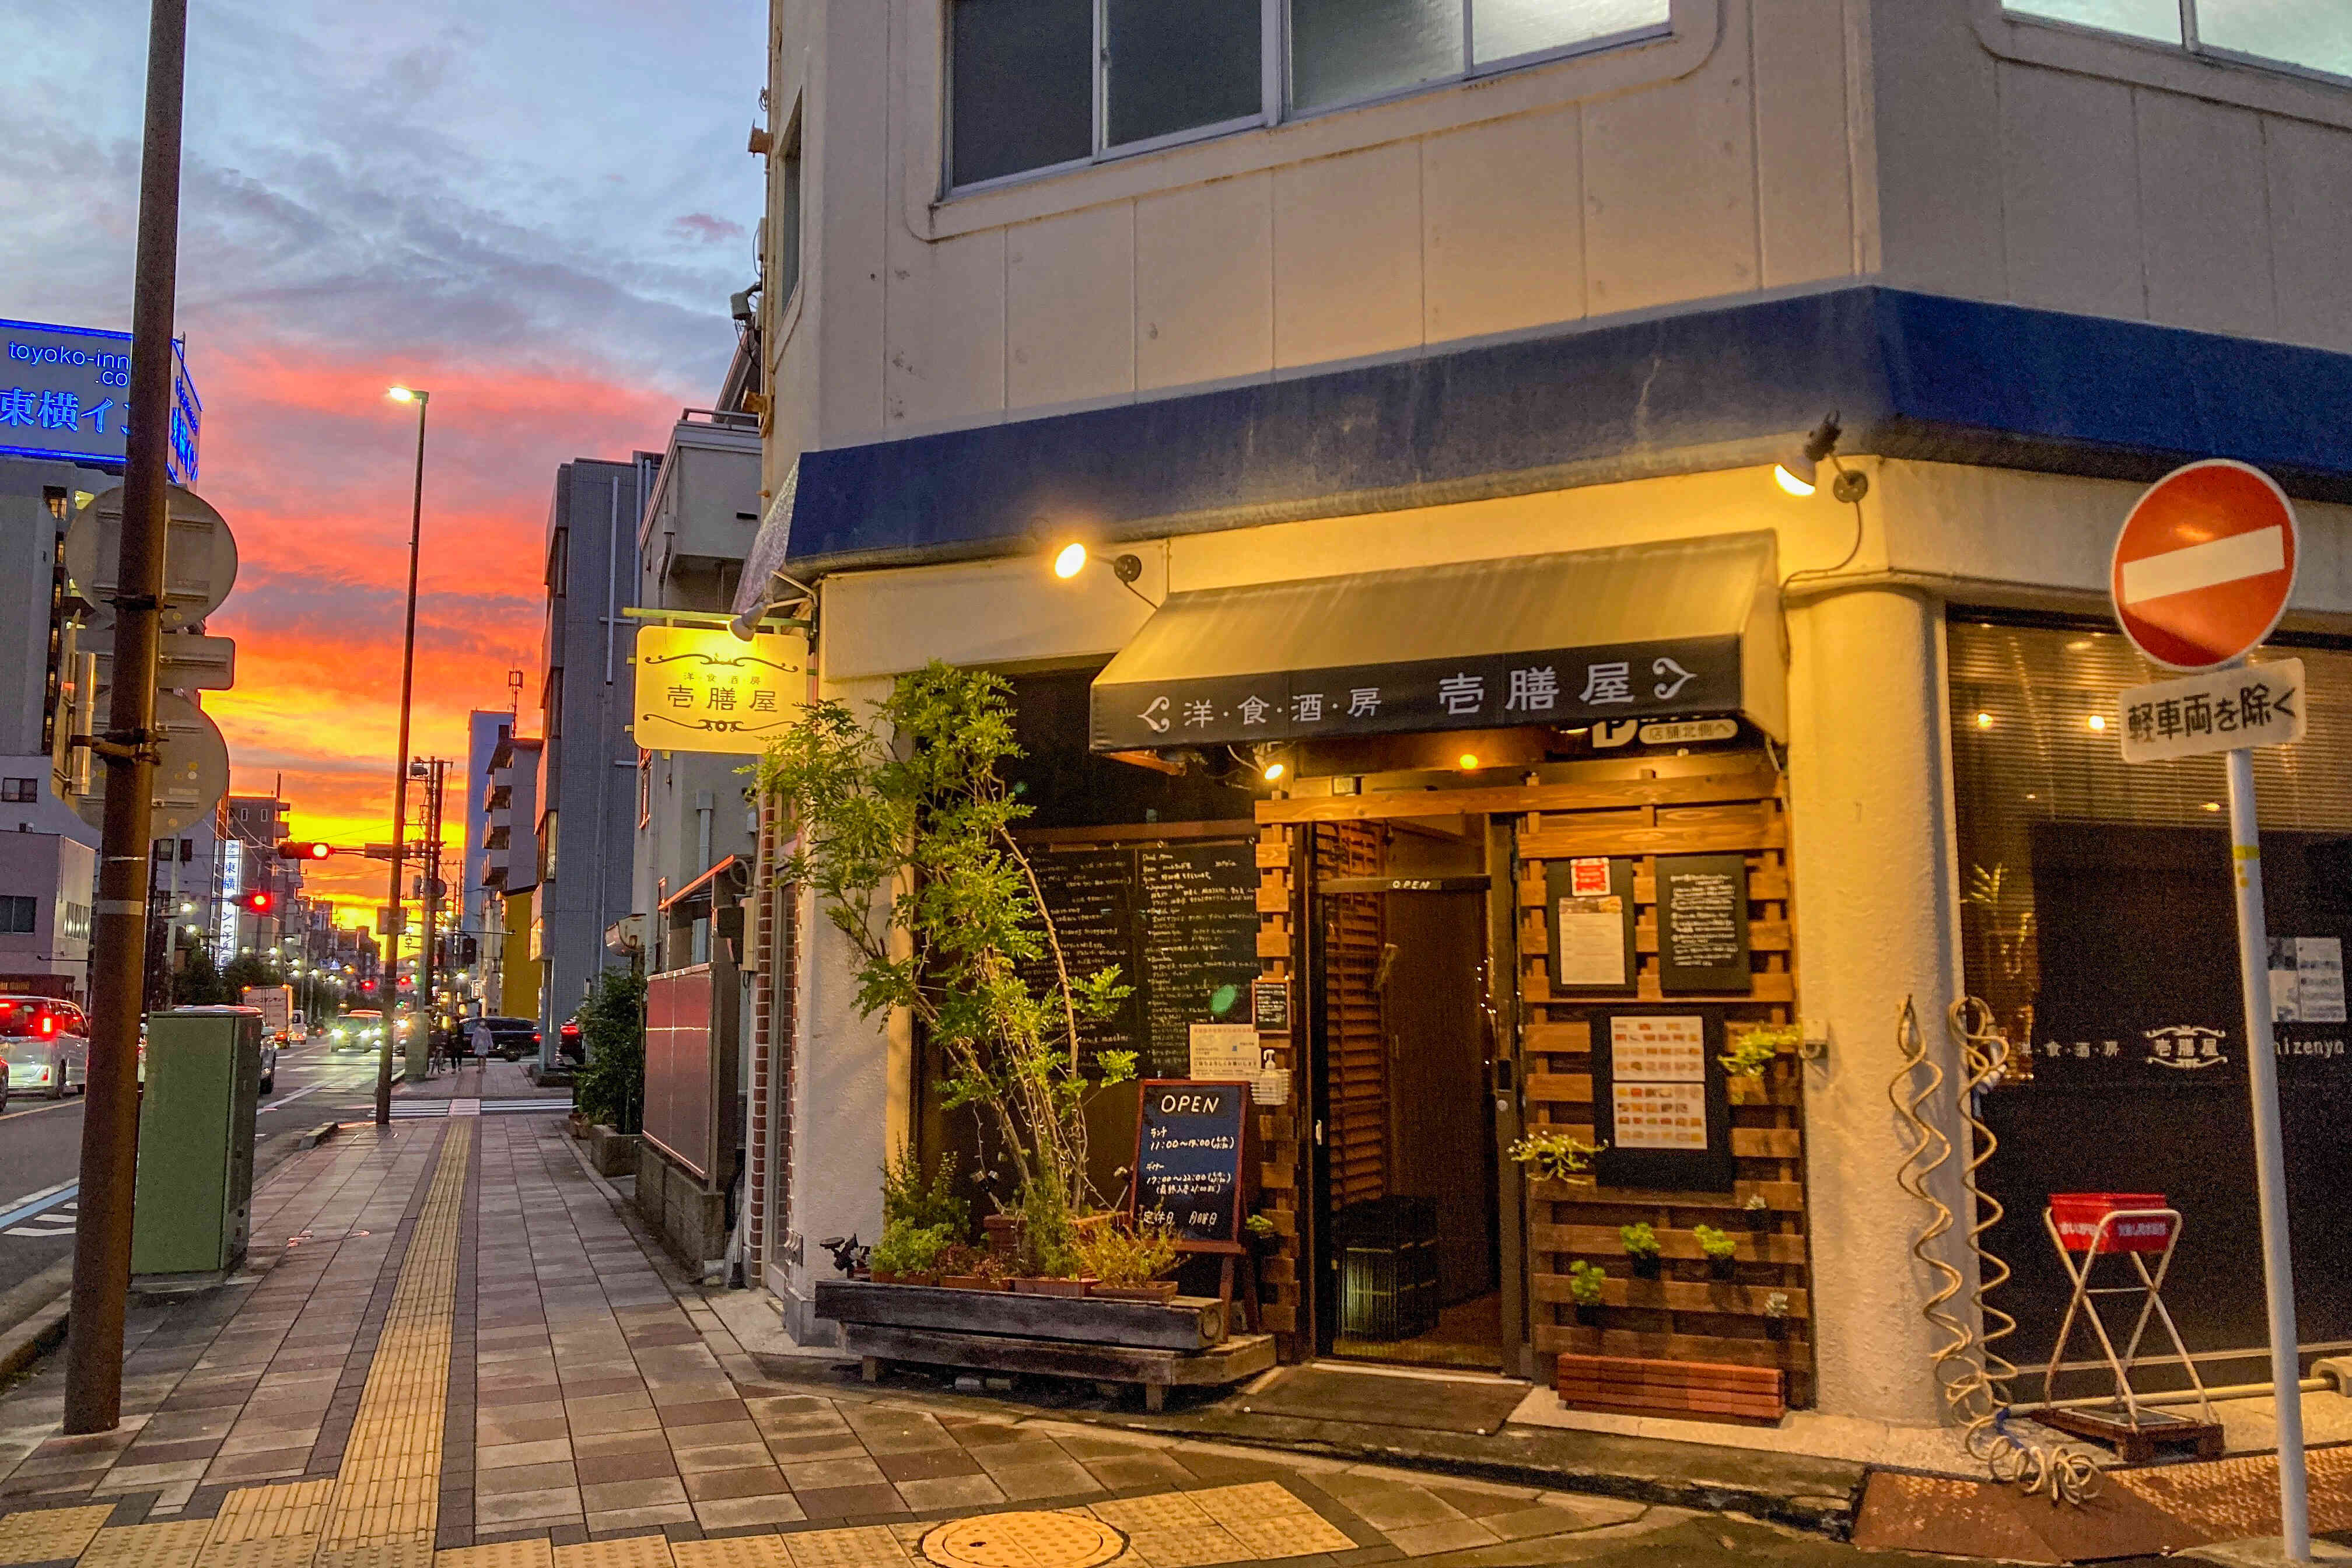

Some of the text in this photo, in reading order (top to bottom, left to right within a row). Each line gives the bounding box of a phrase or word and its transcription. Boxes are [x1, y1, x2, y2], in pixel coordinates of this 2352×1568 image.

[9, 341, 129, 370] toyoko-inn
[94, 370, 128, 387] .co
[1438, 661, 1636, 715] 壱膳屋
[667, 684, 778, 713] 壱膳屋
[2127, 682, 2297, 743] 軽車両を除く
[1392, 880, 1431, 890] OPEN
[1160, 1094, 1219, 1114] OPEN
[1150, 1126, 1167, 1138] ランチ
[1143, 1210, 1217, 1226] 定休日 月曜日
